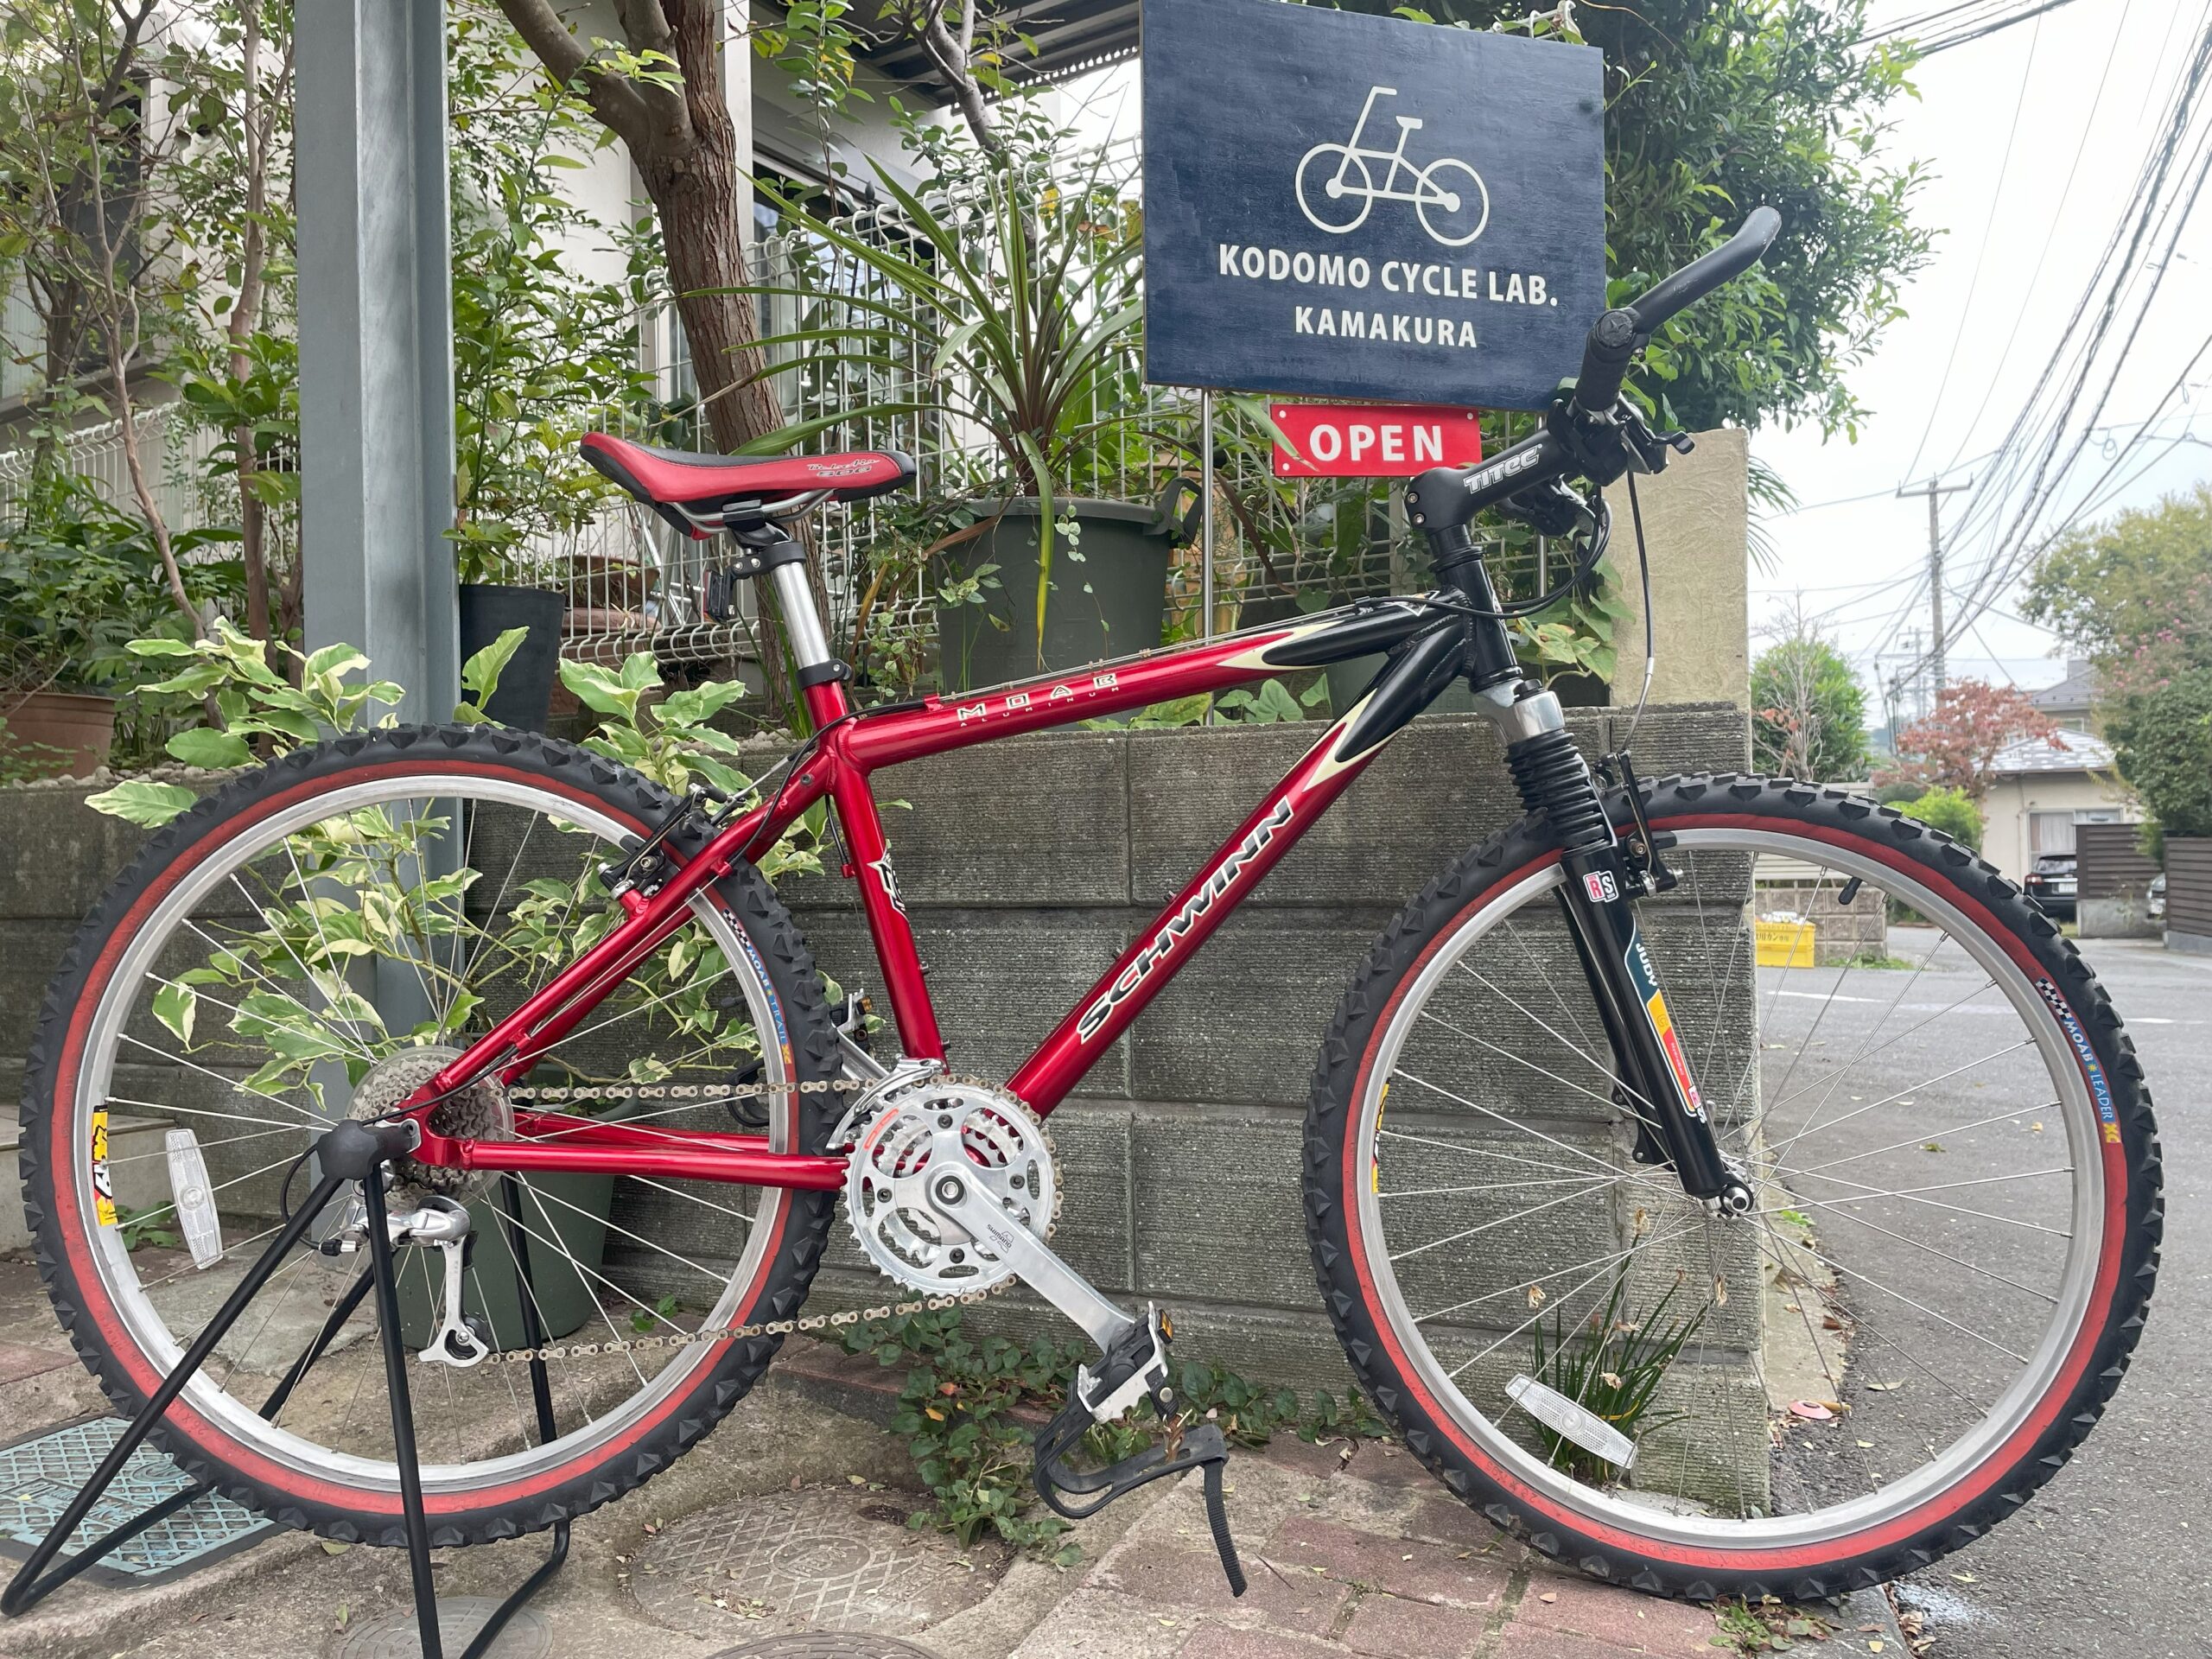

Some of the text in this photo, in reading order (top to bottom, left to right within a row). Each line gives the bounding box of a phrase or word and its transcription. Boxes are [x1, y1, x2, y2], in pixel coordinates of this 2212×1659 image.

[1219, 244, 1559, 308] KODOMO CYCLE LAB.
[1295, 306, 1478, 348] KAMAKURA
[1309, 423, 1443, 461] OPEN
[957, 673, 1117, 721] MOAB
[960, 686, 1120, 728] ALUMINUM
[1077, 795, 1294, 1045] SCHWINN
[1635, 943, 1657, 987] JUDY
[747, 948, 770, 987] MOAB
[771, 998, 787, 1044] TRAIL
[2064, 1020, 2120, 1142] MOAB LEADER XC
[987, 1224, 1012, 1249] SHIMANO
